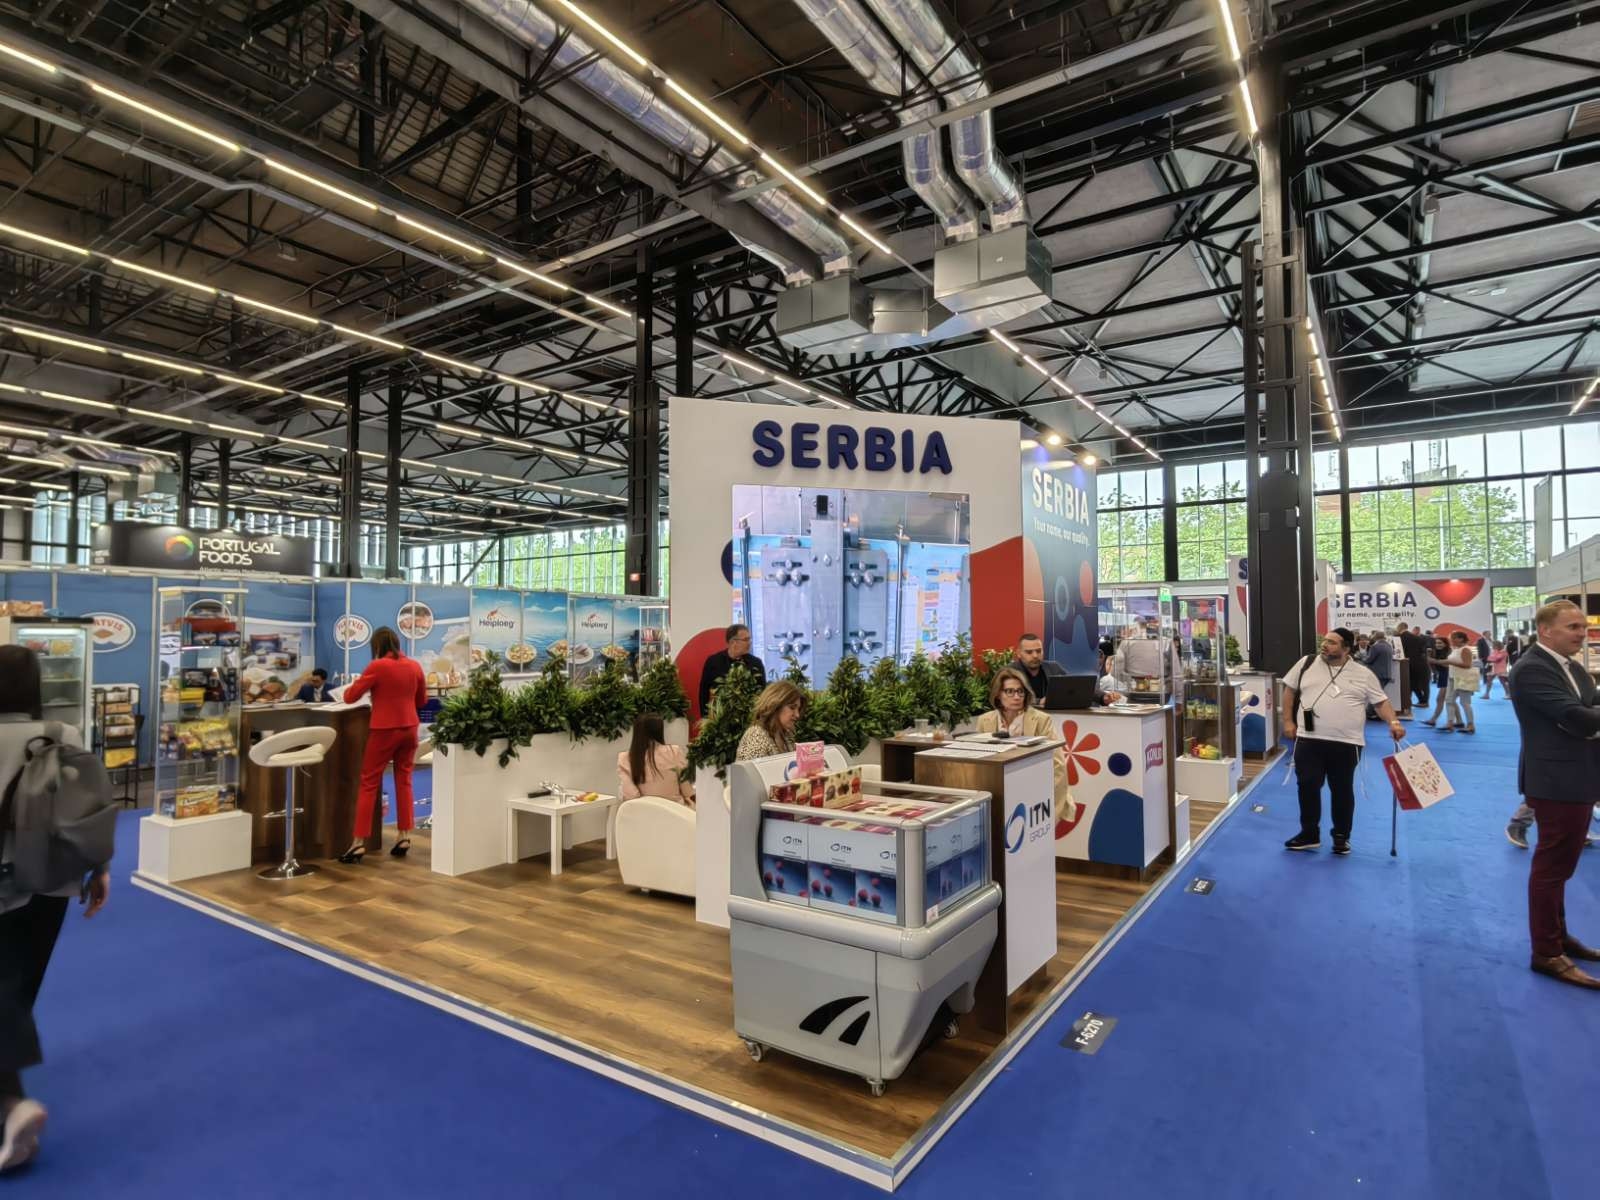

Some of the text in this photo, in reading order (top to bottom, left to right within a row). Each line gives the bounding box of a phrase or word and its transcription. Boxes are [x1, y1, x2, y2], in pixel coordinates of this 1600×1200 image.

[752, 420, 953, 475] SERBIA
[1032, 467, 1090, 528] SERBIA
[199, 537, 281, 555] PORTUGAL
[199, 551, 253, 566] FOODS
[479, 618, 515, 629] Heiploeg
[1029, 798, 1051, 829] ITN
